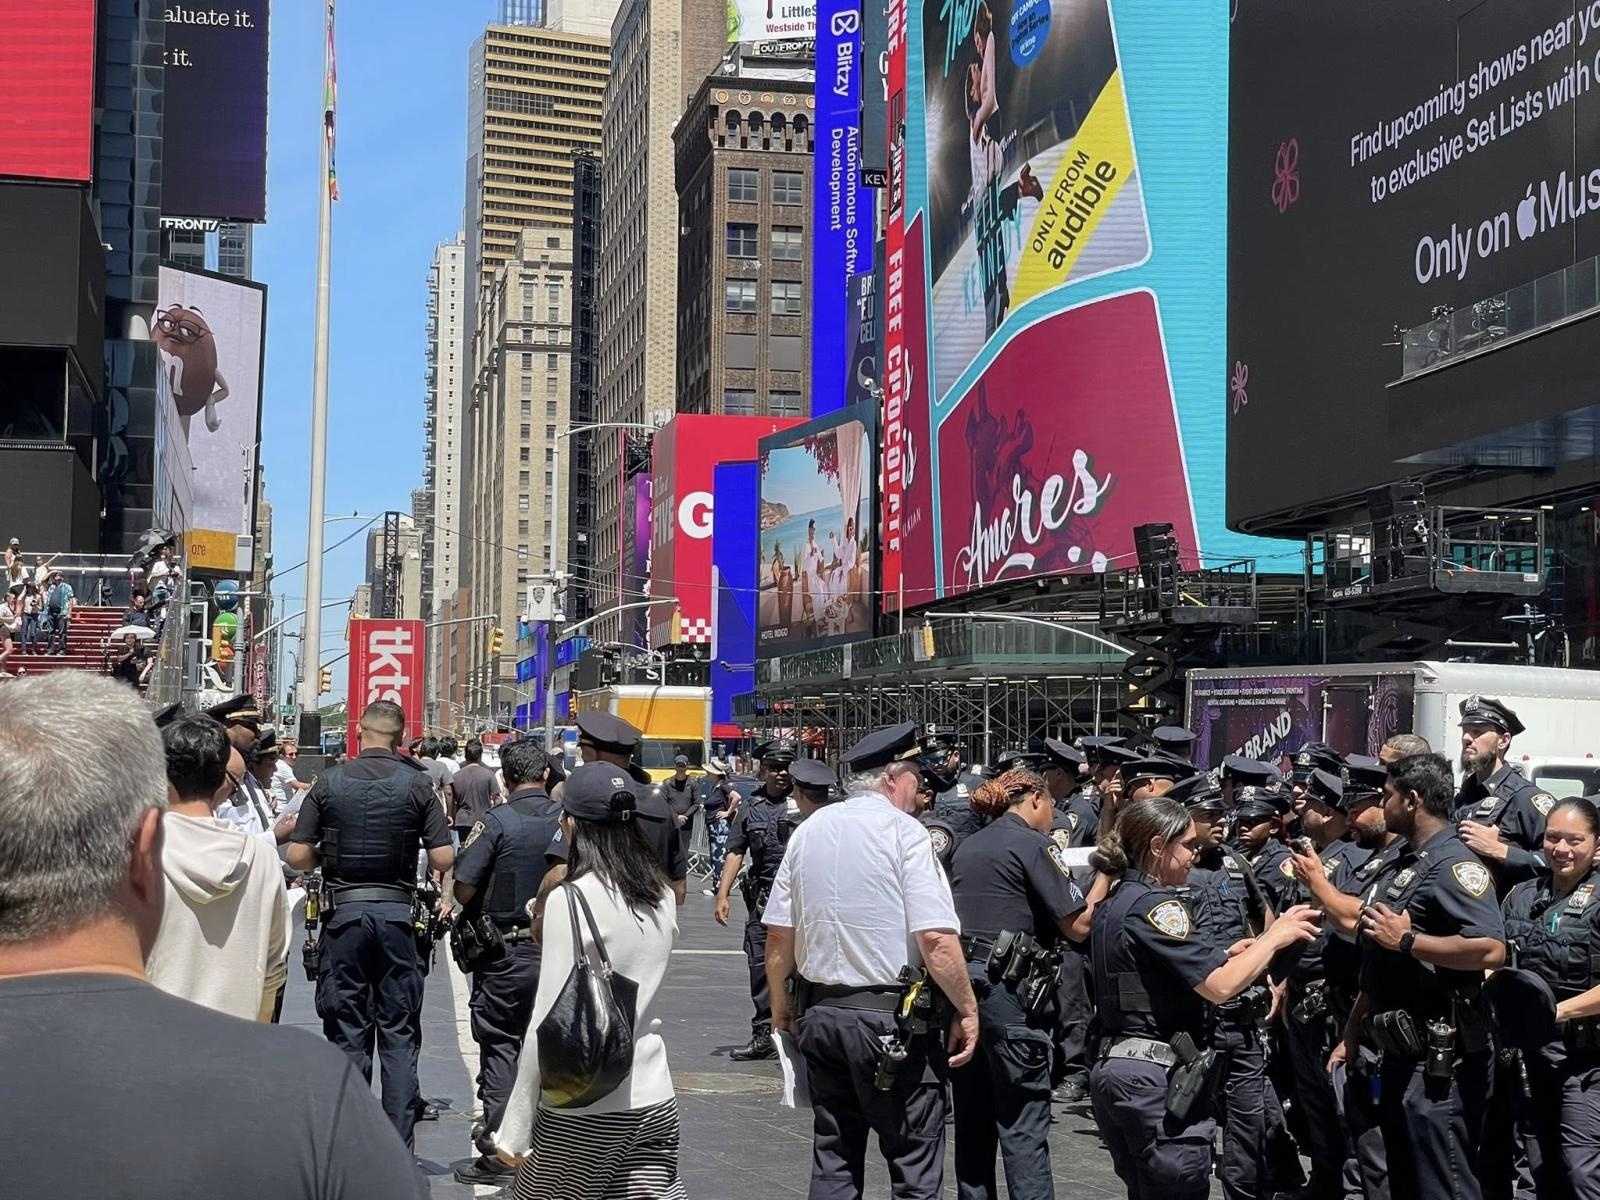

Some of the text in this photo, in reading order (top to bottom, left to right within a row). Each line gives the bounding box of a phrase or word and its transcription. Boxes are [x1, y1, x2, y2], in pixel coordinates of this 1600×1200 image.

[173, 48, 193, 67] it.
[234, 10, 255, 28] it.
[766, 22, 805, 33] Westside
[834, 42, 853, 97] Blitzy
[1351, 122, 1383, 167] Find
[1385, 80, 1465, 149] upcoming
[1469, 45, 1527, 100] shows
[1530, 15, 1576, 64] near
[846, 126, 859, 225] Autonomous
[1371, 173, 1387, 203] to
[1389, 135, 1464, 194] exclusive
[1466, 111, 1497, 154] Set
[1500, 88, 1543, 136] Lists
[1546, 59, 1590, 111] with
[830, 128, 843, 231] Development
[1032, 150, 1090, 254] ONLY FROM
[1048, 160, 1117, 270] audible
[888, 248, 903, 333] FREE
[1415, 223, 1473, 284] Only
[1477, 211, 1510, 258] on
[953, 448, 1112, 593] Amores
[1245, 711, 1292, 759] BRAND
